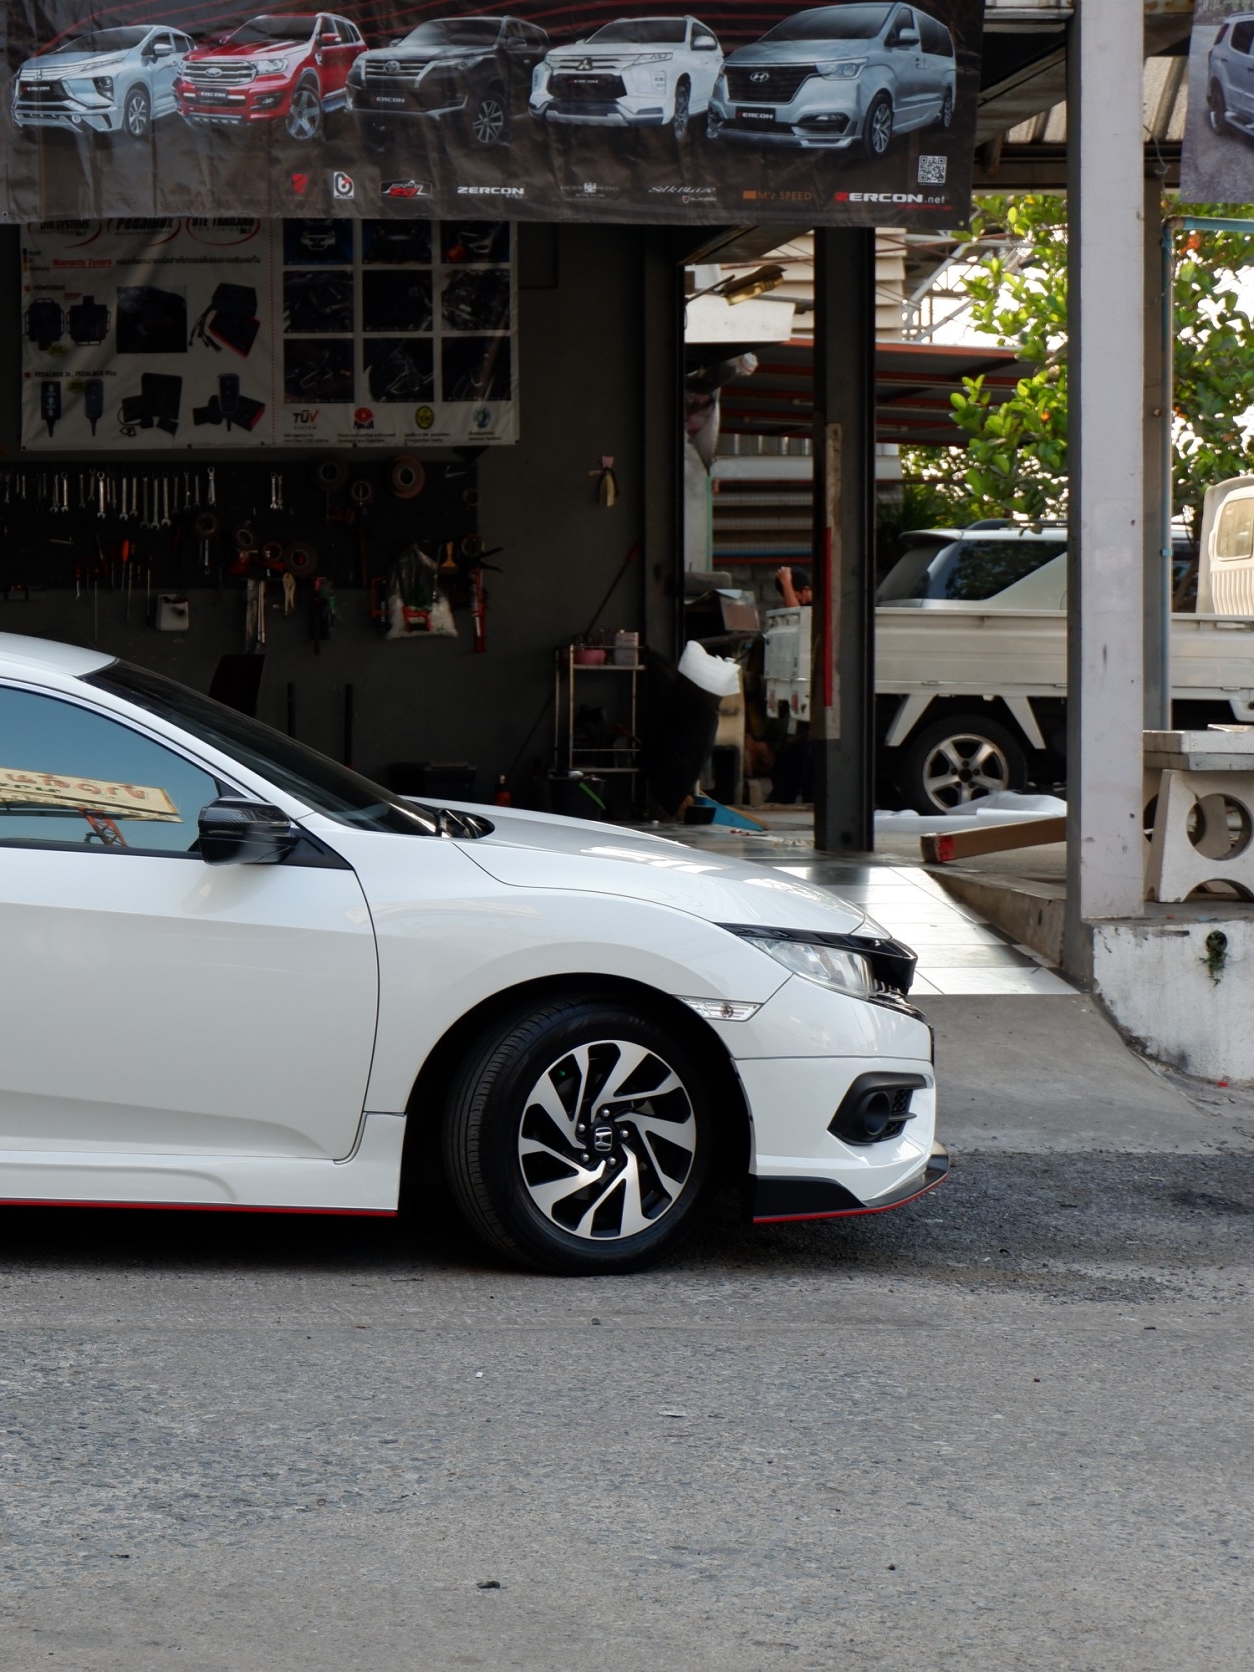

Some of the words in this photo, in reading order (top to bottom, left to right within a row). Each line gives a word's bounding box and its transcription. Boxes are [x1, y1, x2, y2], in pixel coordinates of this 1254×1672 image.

[457, 186, 525, 195] ZERCON
[779, 191, 812, 200] SPEED
[52, 258, 86, 267] Warranty
[88, 258, 112, 267] 2years
